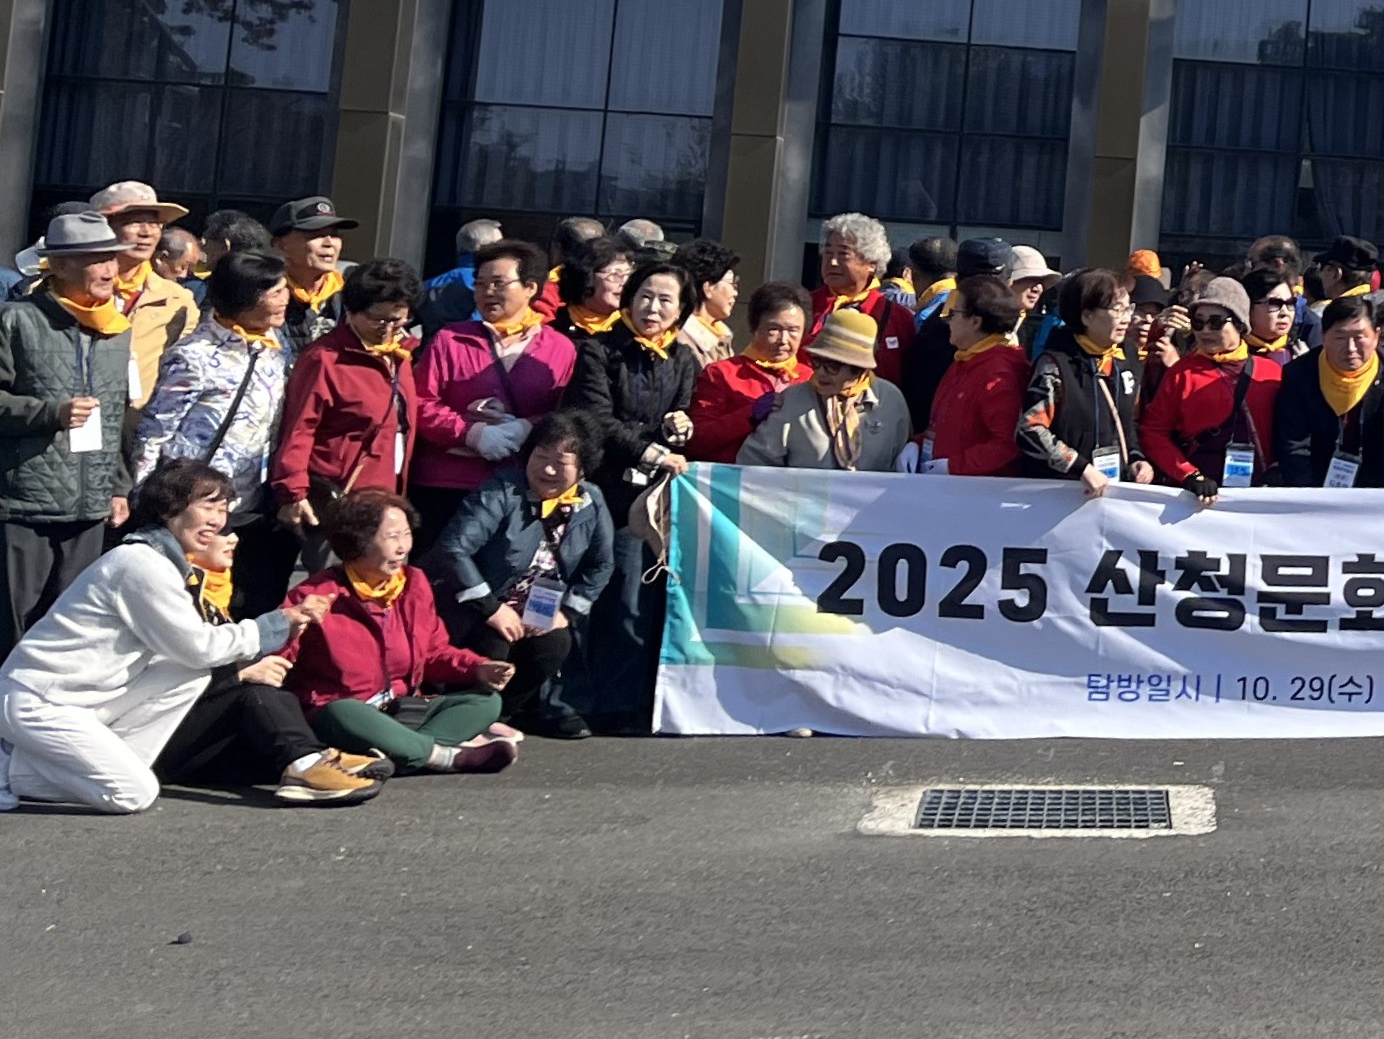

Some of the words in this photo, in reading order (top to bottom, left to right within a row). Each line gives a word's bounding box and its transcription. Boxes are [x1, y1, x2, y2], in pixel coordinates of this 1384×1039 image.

[817, 541, 1050, 623] 2025
[1086, 673, 1201, 703] 탐방일시
[1236, 675, 1278, 702] 10.
[1289, 673, 1375, 704] 29(수)
